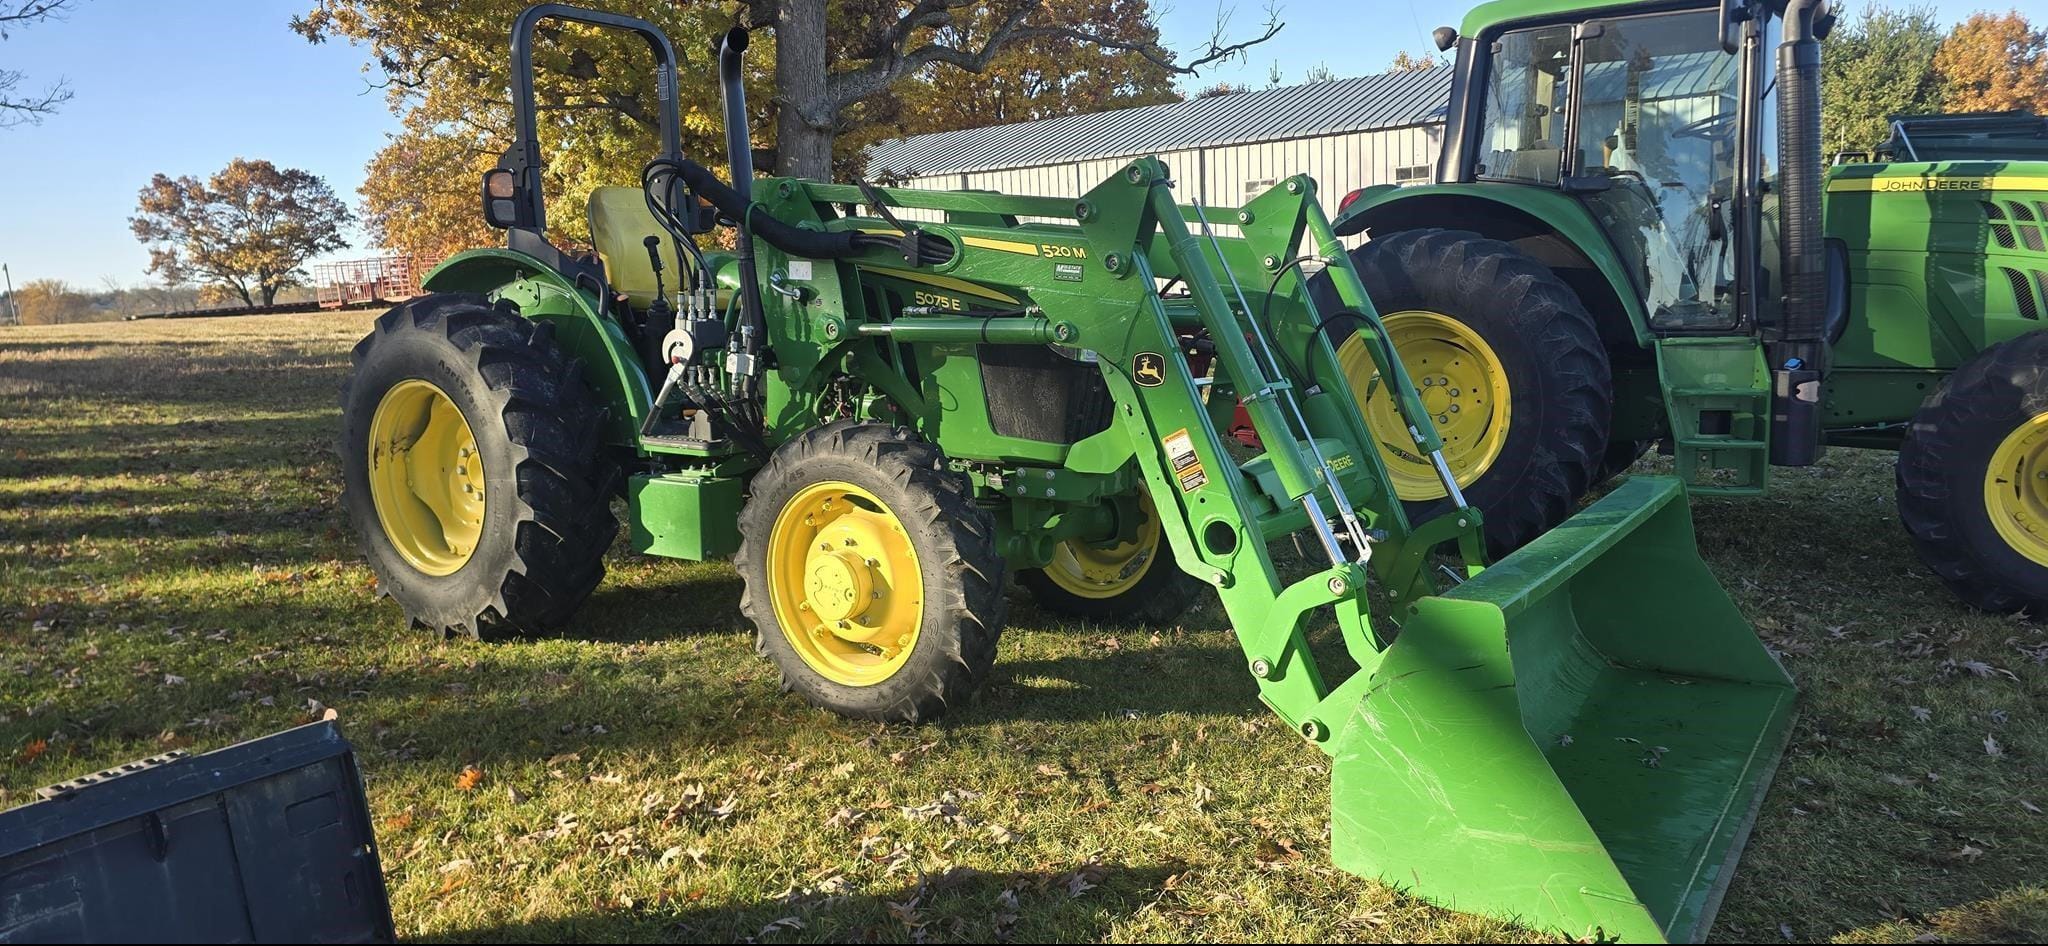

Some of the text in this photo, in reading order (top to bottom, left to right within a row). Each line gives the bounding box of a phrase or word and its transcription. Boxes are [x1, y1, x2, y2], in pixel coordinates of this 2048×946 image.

[1881, 179, 1980, 190] JOHN DEERE
[1041, 244, 1087, 259] 520 M
[915, 291, 961, 311] 5075 E
